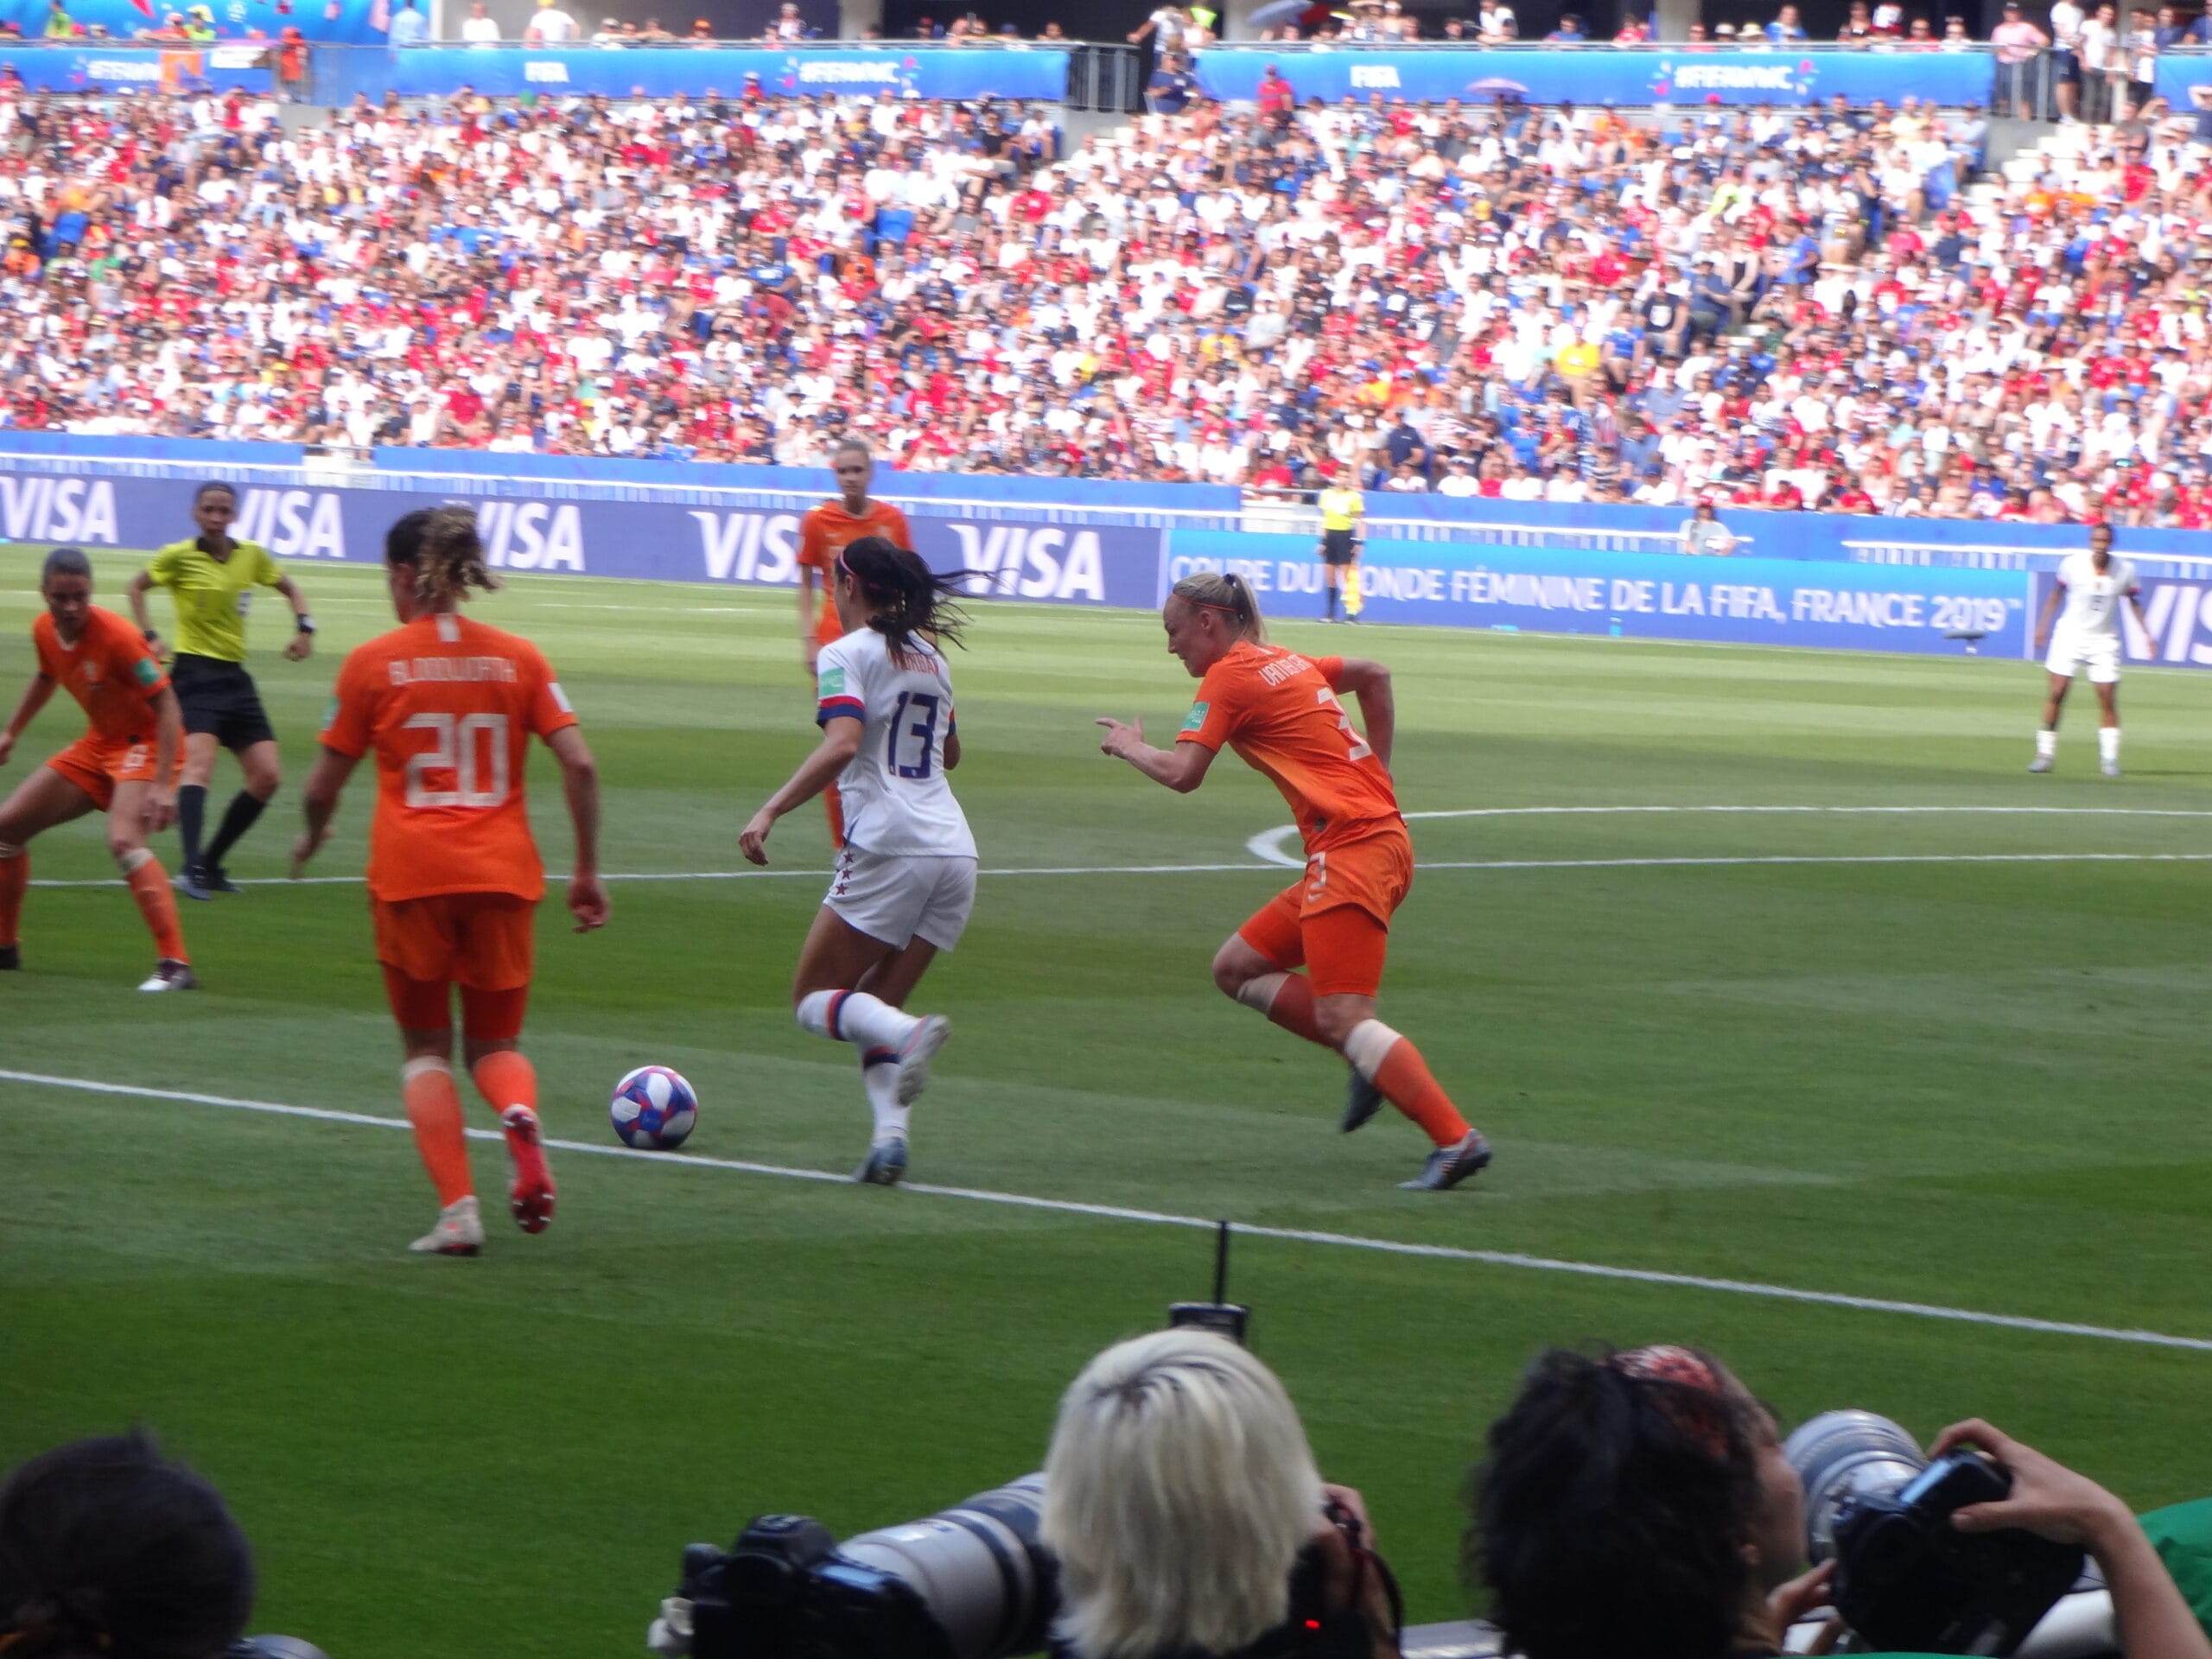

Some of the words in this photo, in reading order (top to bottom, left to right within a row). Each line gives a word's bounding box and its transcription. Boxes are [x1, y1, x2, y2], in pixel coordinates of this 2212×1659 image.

[0, 476, 118, 543] VISA
[686, 511, 804, 584] VIS
[946, 524, 1105, 601] VISA
[1278, 561, 1325, 594] DU
[1336, 566, 1446, 602] ONDE
[1611, 579, 1656, 613] DE
[1660, 582, 1706, 616] LA
[1790, 588, 1926, 628] FRANCE
[402, 713, 508, 808] 20
[888, 691, 939, 779] 13
